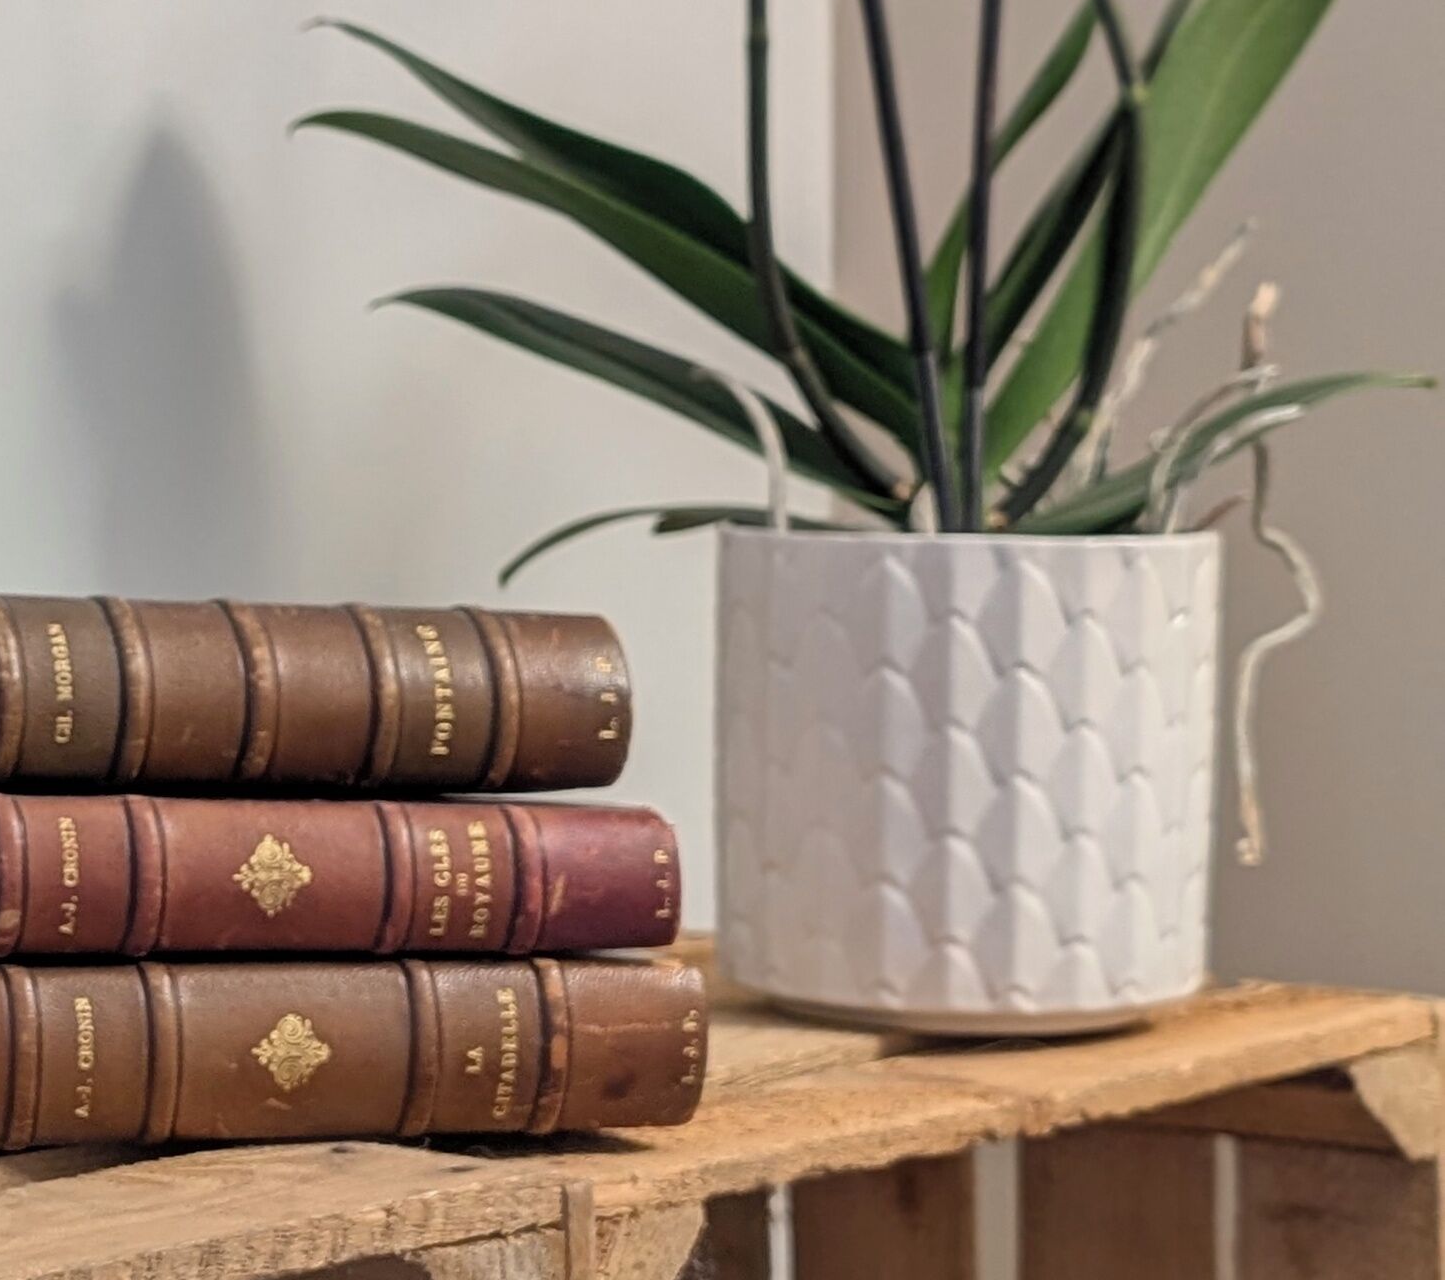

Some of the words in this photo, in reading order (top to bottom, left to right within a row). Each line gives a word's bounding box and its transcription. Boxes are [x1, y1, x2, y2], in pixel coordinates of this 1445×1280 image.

[46, 623, 74, 701] MORGAN
[416, 624, 454, 756] FONTAINE
[57, 816, 80, 888] CRONIN
[467, 820, 493, 939] ROYAUME
[429, 895, 451, 937] LES
[74, 996, 95, 1071] CRONIN
[464, 1045, 484, 1073] LA
[492, 986, 518, 1119] CITADELLE
